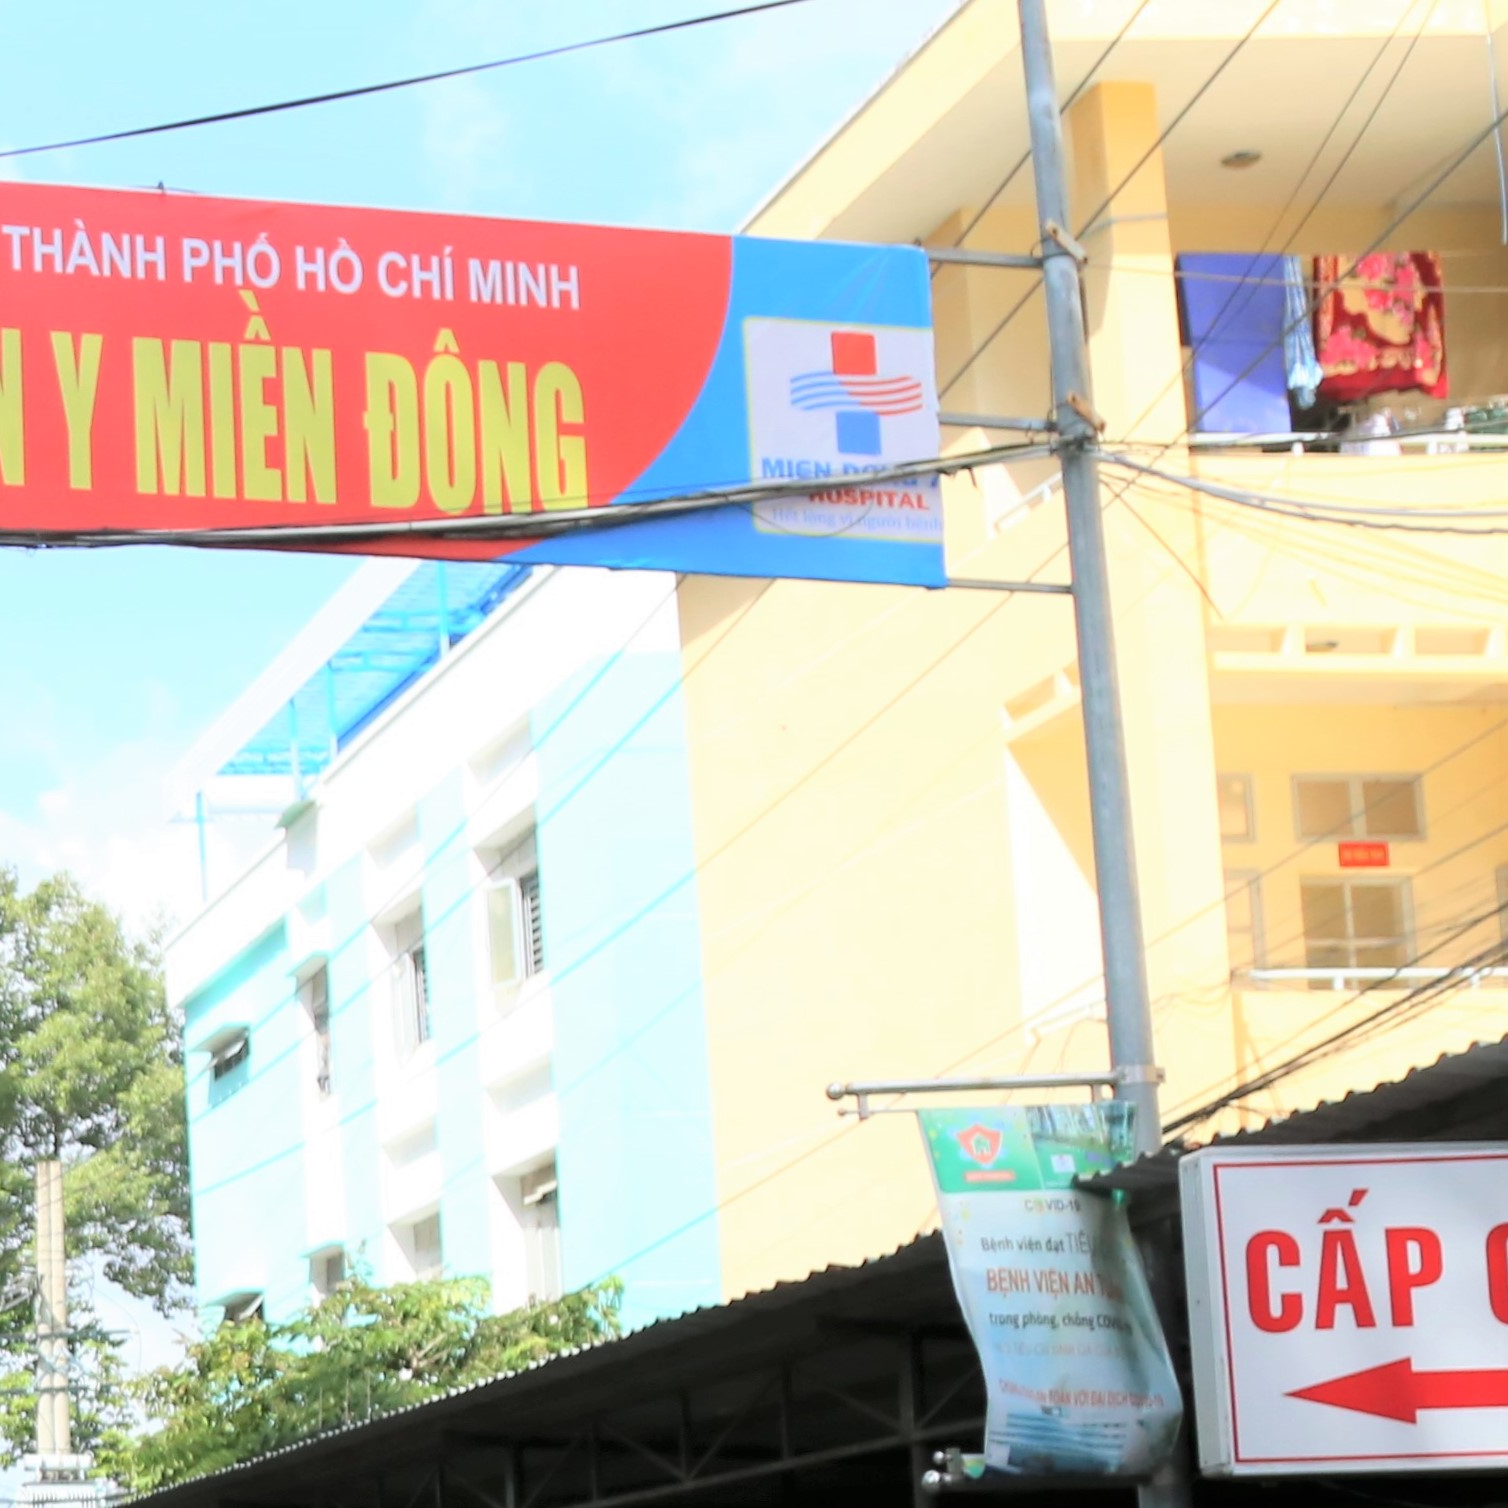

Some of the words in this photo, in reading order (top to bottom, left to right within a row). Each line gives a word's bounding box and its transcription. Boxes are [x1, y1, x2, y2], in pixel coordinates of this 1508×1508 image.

[2, 214, 167, 282] THÀNH
[182, 229, 280, 290] PHỐ
[294, 235, 365, 296] HỒ
[378, 243, 457, 302] CHÍ
[469, 256, 581, 311] MINH
[52, 331, 102, 490] Y
[133, 289, 338, 506] MIỀN
[363, 326, 587, 512] ĐÔNG
[987, 1267, 1031, 1299] BỆNH
[1034, 1269, 1070, 1301] VIỆN
[1074, 1271, 1096, 1296] AN
[1245, 1187, 1444, 1335] CẤP
[989, 1312, 1020, 1328] trong
